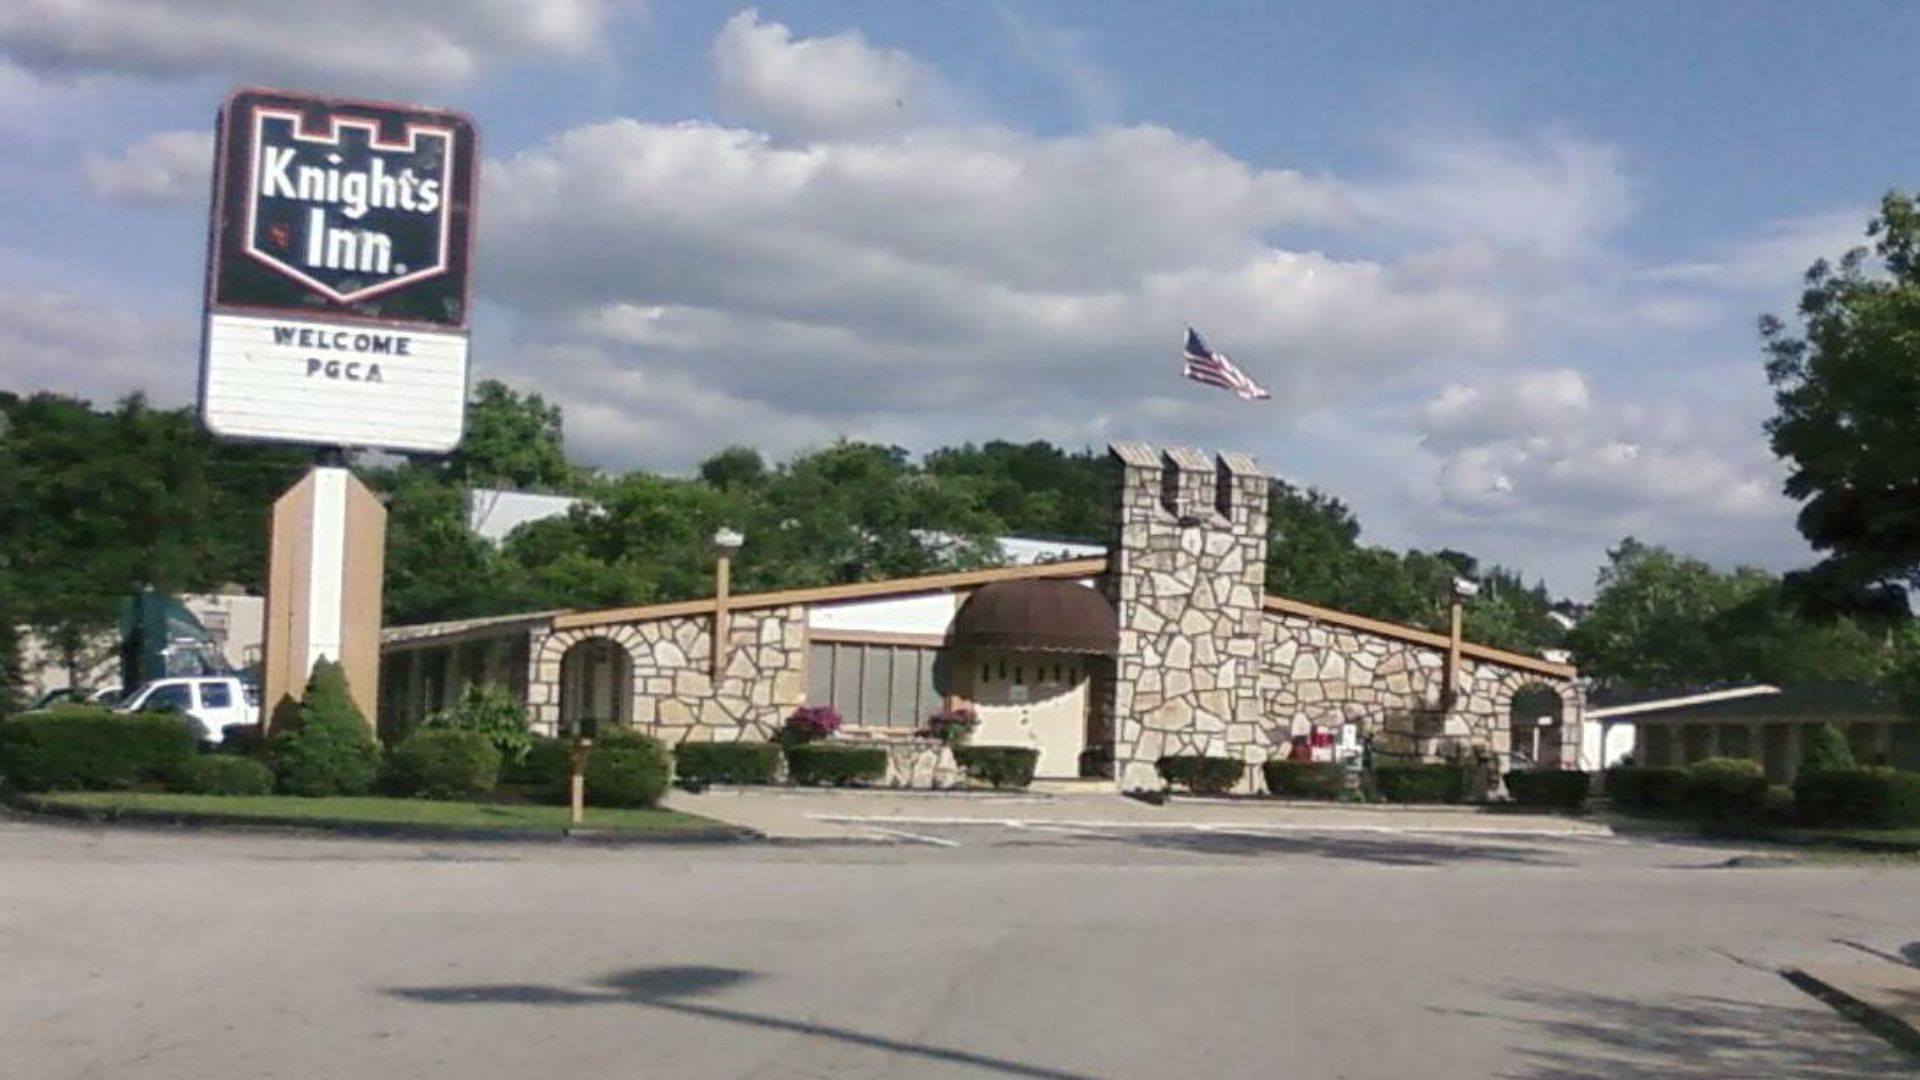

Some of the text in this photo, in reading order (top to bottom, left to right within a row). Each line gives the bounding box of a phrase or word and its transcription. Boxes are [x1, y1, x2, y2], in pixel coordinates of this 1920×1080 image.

[262, 146, 440, 218] Knights
[273, 326, 411, 355] WELCOME
[306, 358, 384, 382] PGCA
